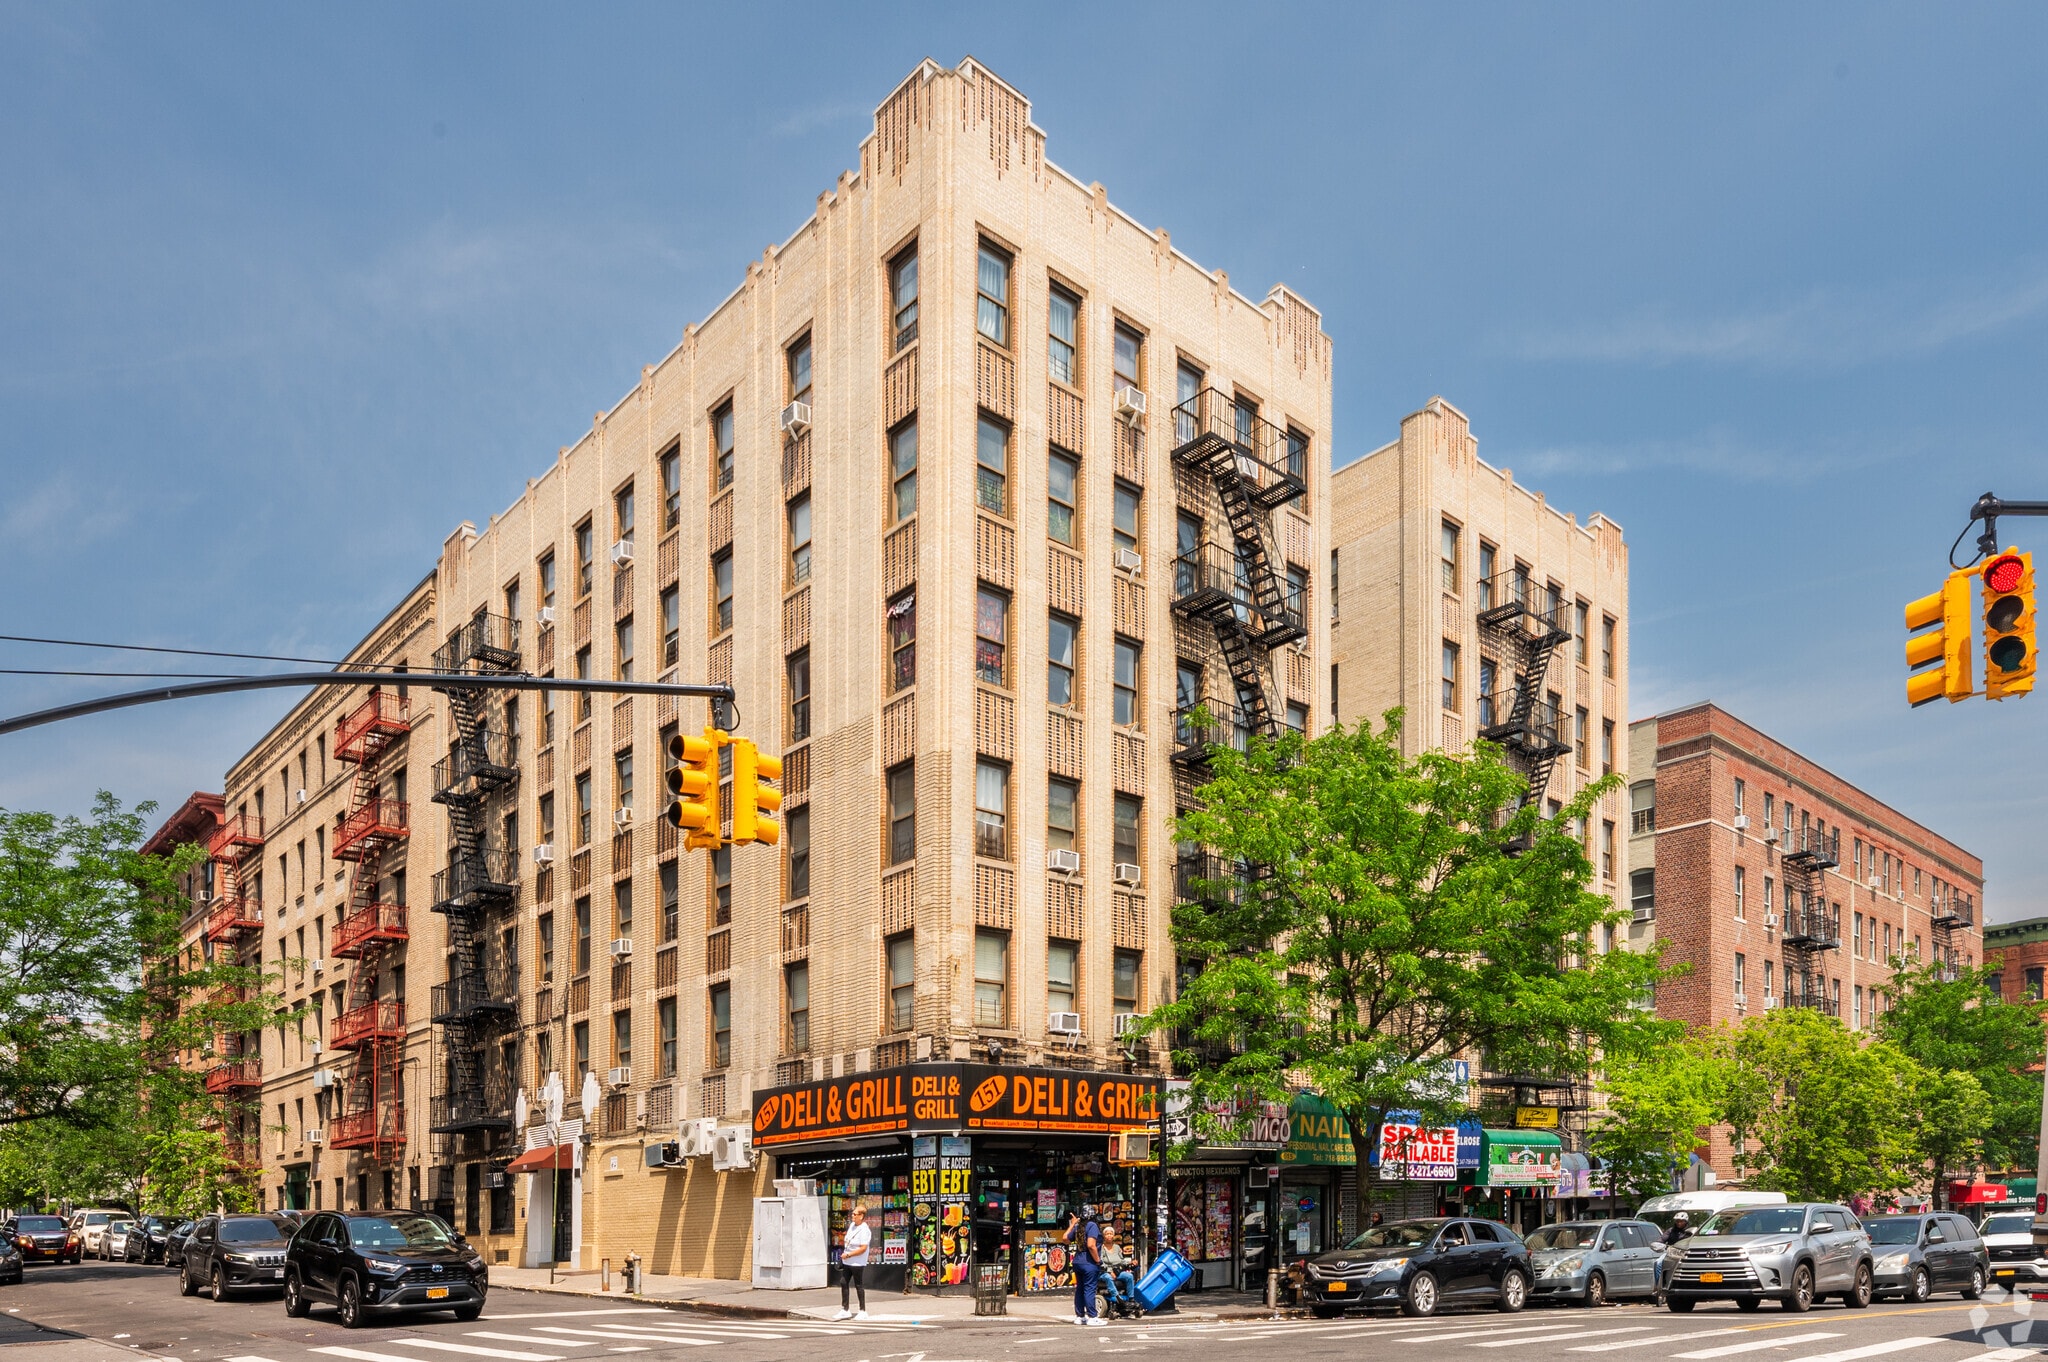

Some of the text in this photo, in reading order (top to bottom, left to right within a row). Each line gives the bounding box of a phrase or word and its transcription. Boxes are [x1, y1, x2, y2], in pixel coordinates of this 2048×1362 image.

[912, 1075, 960, 1096] DELI &
[974, 1079, 1002, 1109] 151
[781, 1076, 907, 1129] DELI & GRILL
[1013, 1075, 1069, 1116] DELI
[1075, 1079, 1093, 1117] &
[1098, 1081, 1162, 1120] GRILL
[757, 1101, 776, 1128] 151
[914, 1099, 959, 1119] GRILL
[1300, 1114, 1366, 1138] NAIL
[1383, 1126, 1455, 1145] SPACE
[1456, 1136, 1480, 1145] ELROSE
[920, 1157, 936, 1169] ACCEPT
[941, 1157, 971, 1169] WE ACCEPT
[1382, 1144, 1455, 1162] AVAILABLE
[1166, 1166, 1240, 1177] PRODUCTOS MEXICANOS
[1399, 1165, 1454, 1177] 2-271-6690
[1525, 1165, 1547, 1173] DIAMANTE
[913, 1169, 936, 1194] EBT
[941, 1169, 971, 1194] EBT
